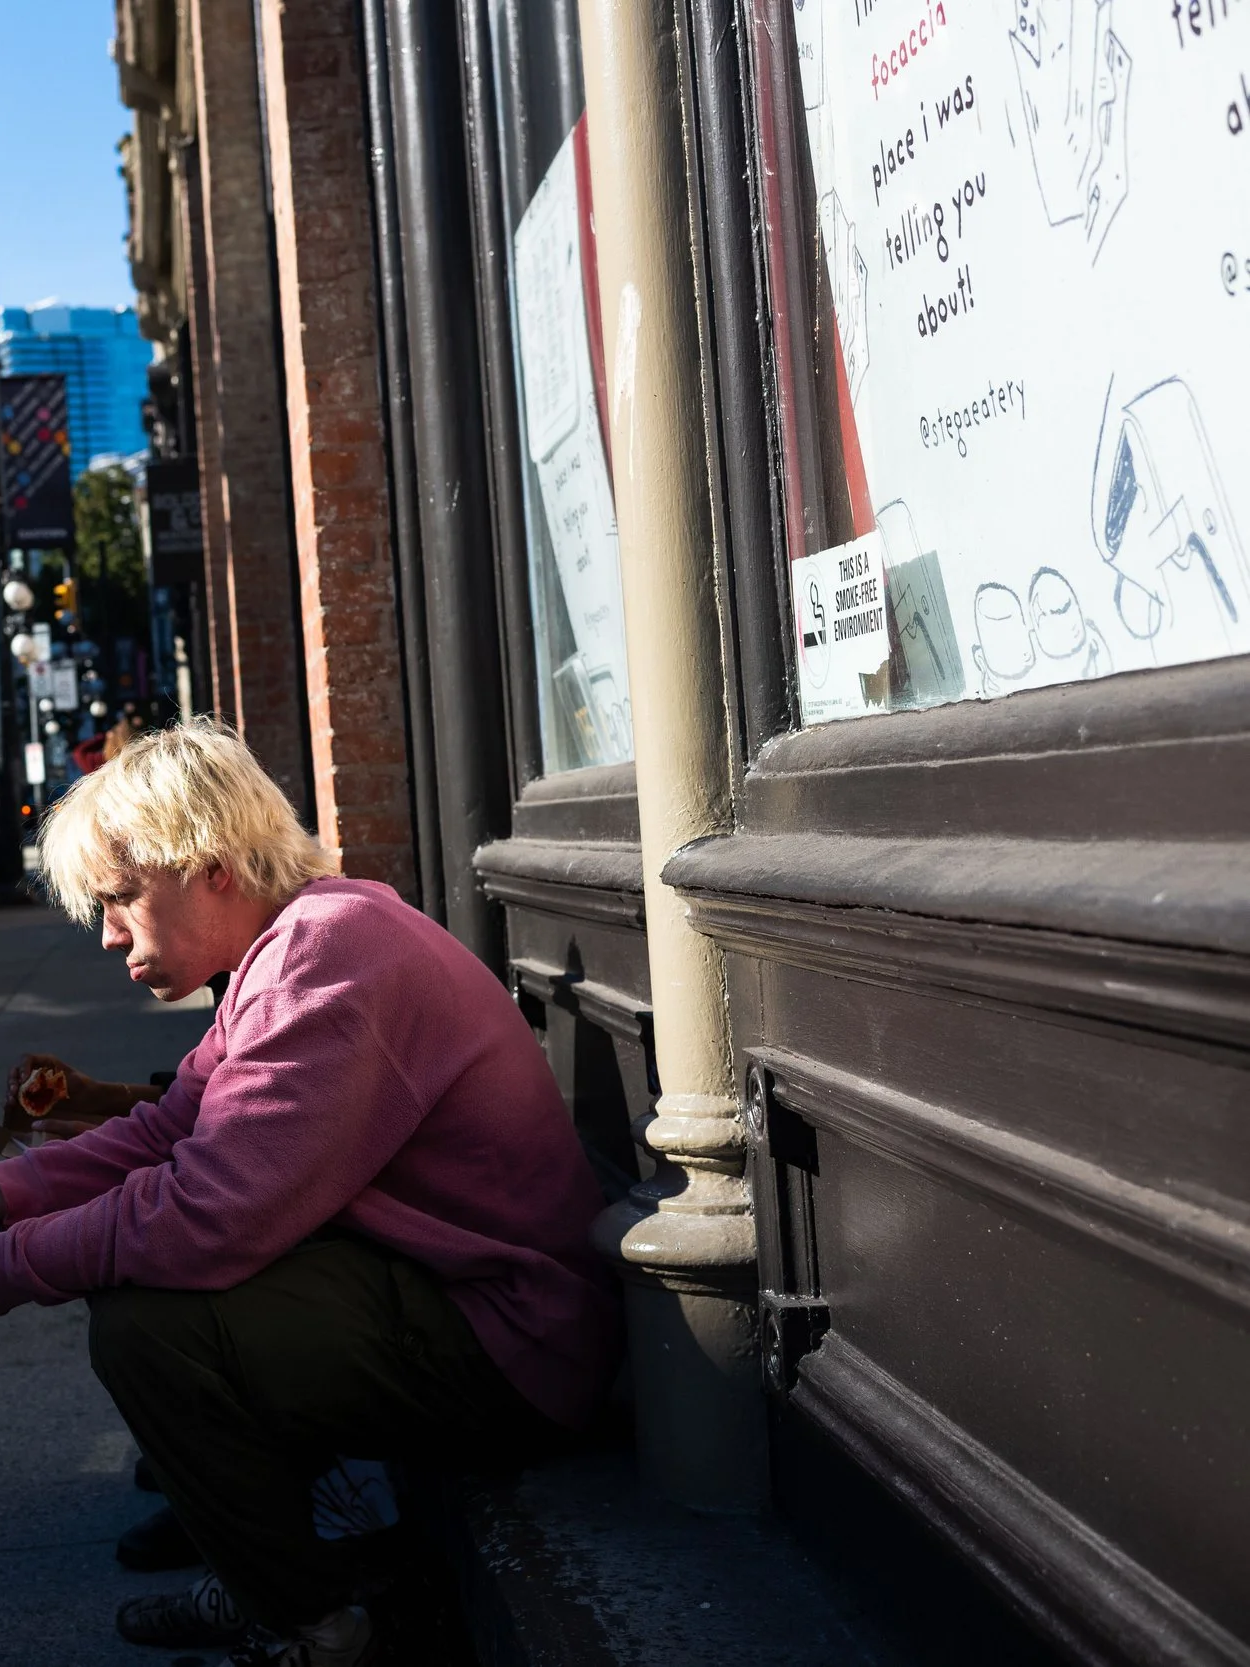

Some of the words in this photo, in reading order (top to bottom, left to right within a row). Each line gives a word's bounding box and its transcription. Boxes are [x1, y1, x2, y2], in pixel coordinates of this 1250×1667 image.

[871, 0, 946, 101] focaccia
[872, 128, 914, 207] place
[920, 101, 929, 142] i
[935, 75, 975, 129] was
[885, 201, 949, 270] telling
[952, 171, 986, 238] you
[917, 263, 975, 337] about!
[919, 379, 1026, 459] @stegaeatery
[835, 577, 878, 613] SMOKE-FREE
[838, 556, 855, 582] THIS
[855, 553, 863, 577] IS
[863, 551, 870, 574] A
[833, 606, 883, 642] ENVIRONMENT
